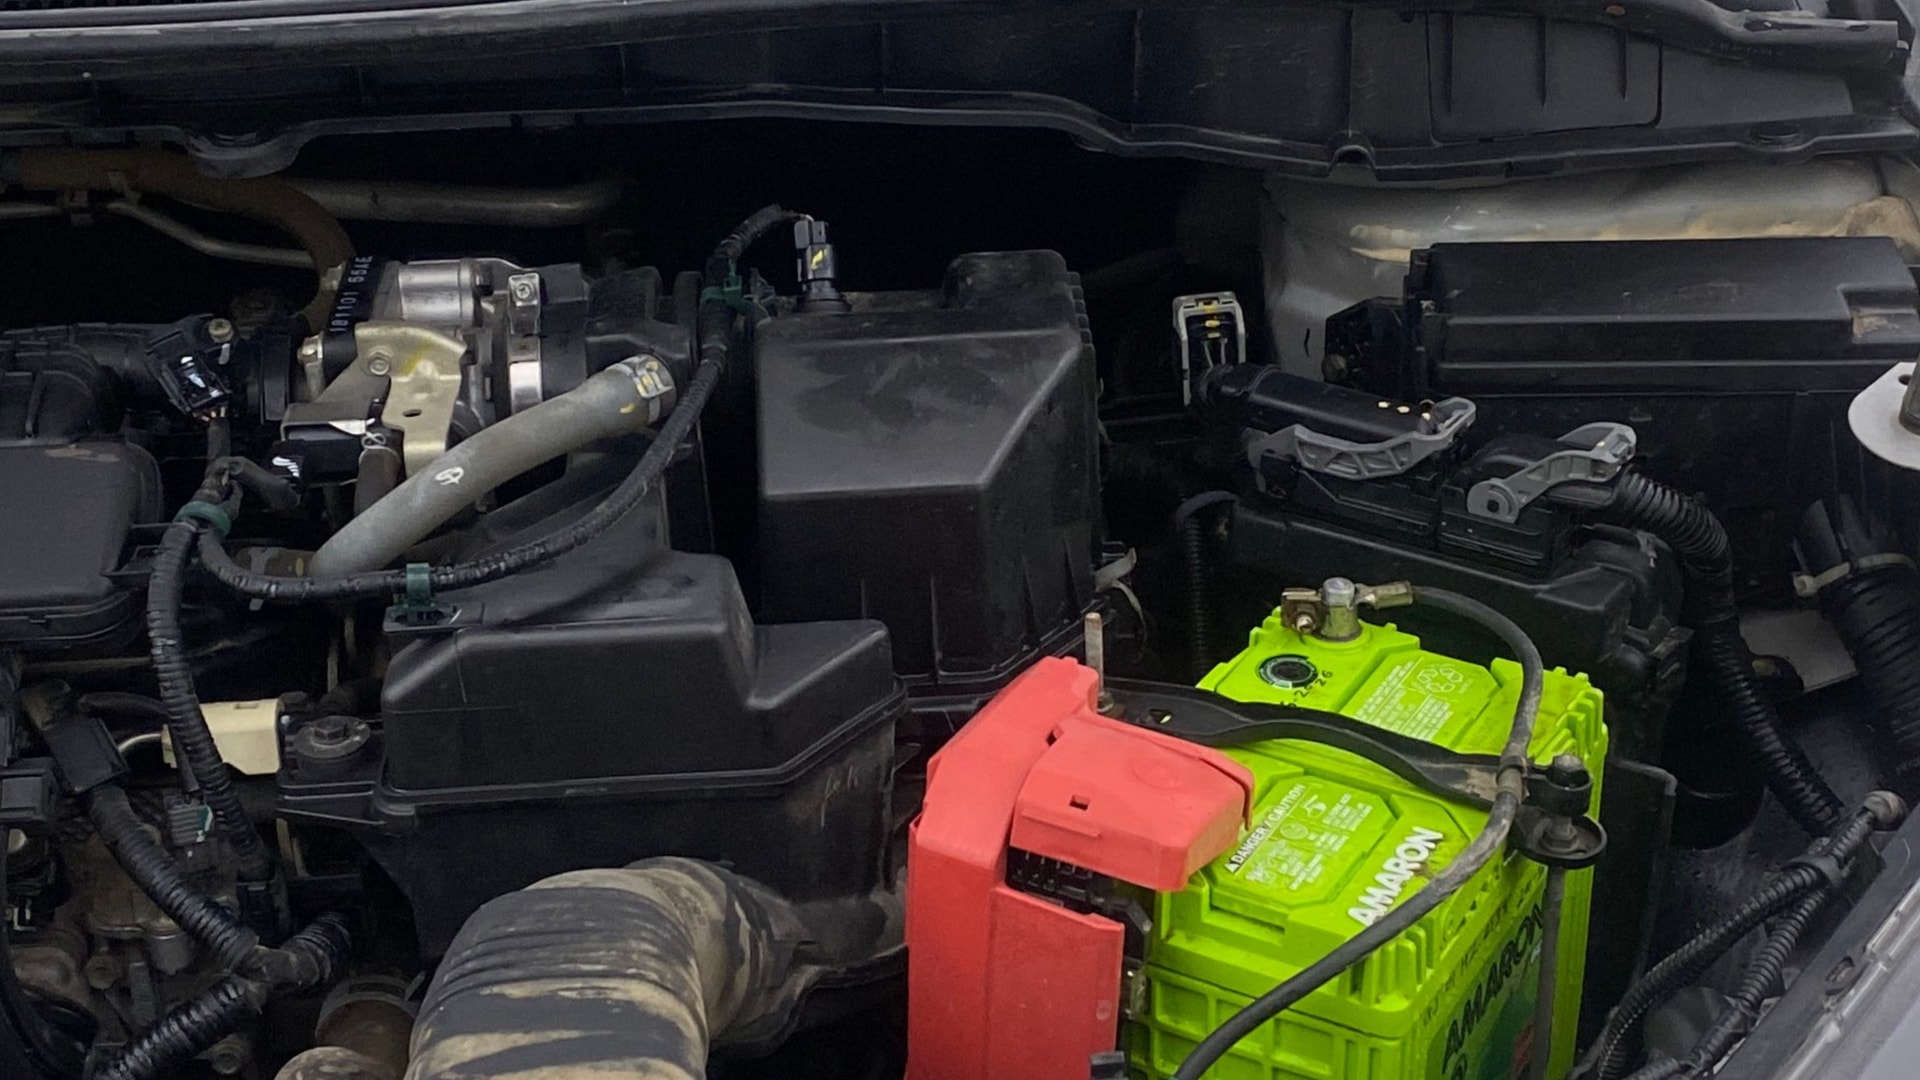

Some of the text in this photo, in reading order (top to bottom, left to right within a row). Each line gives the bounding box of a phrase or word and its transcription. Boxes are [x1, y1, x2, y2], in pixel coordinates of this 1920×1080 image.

[1230, 825, 1270, 864] DANGER
[1268, 783, 1306, 821] CAUTION
[1347, 825, 1444, 927] AMARON
